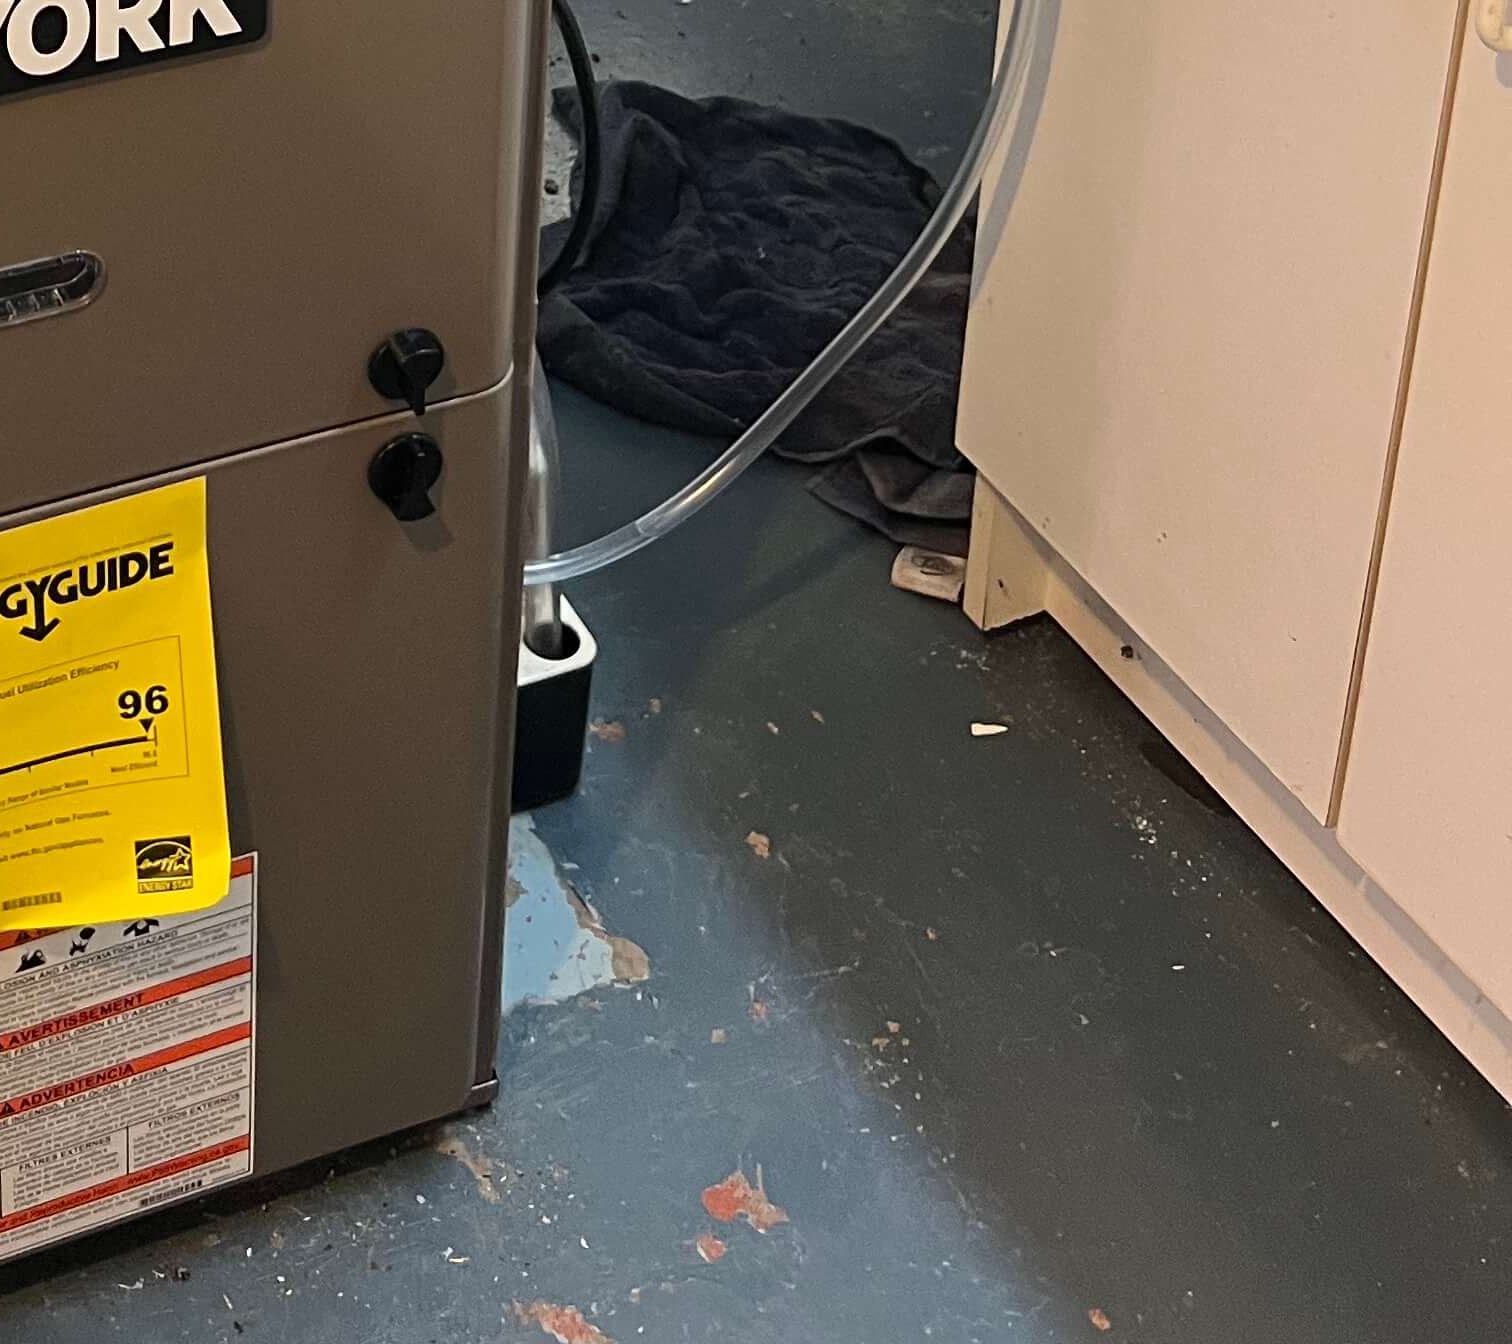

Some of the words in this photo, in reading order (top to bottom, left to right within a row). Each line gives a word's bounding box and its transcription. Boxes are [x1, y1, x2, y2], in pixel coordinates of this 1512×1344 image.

[17, 672, 68, 694] Utilization
[70, 660, 121, 681] Efficiency
[117, 685, 170, 720] 96
[139, 881, 171, 893] ENERGY
[172, 878, 193, 890] STAR
[38, 966, 60, 980] AND
[63, 943, 135, 971] ASPHYXIATION
[137, 929, 179, 946] HAZARD
[8, 993, 144, 1046] AVERTISSEMENT
[19, 1064, 135, 1111] ADVERTENCIA
[18, 1153, 59, 1171] FILTRES
[60, 1136, 112, 1159] EXTERNES
